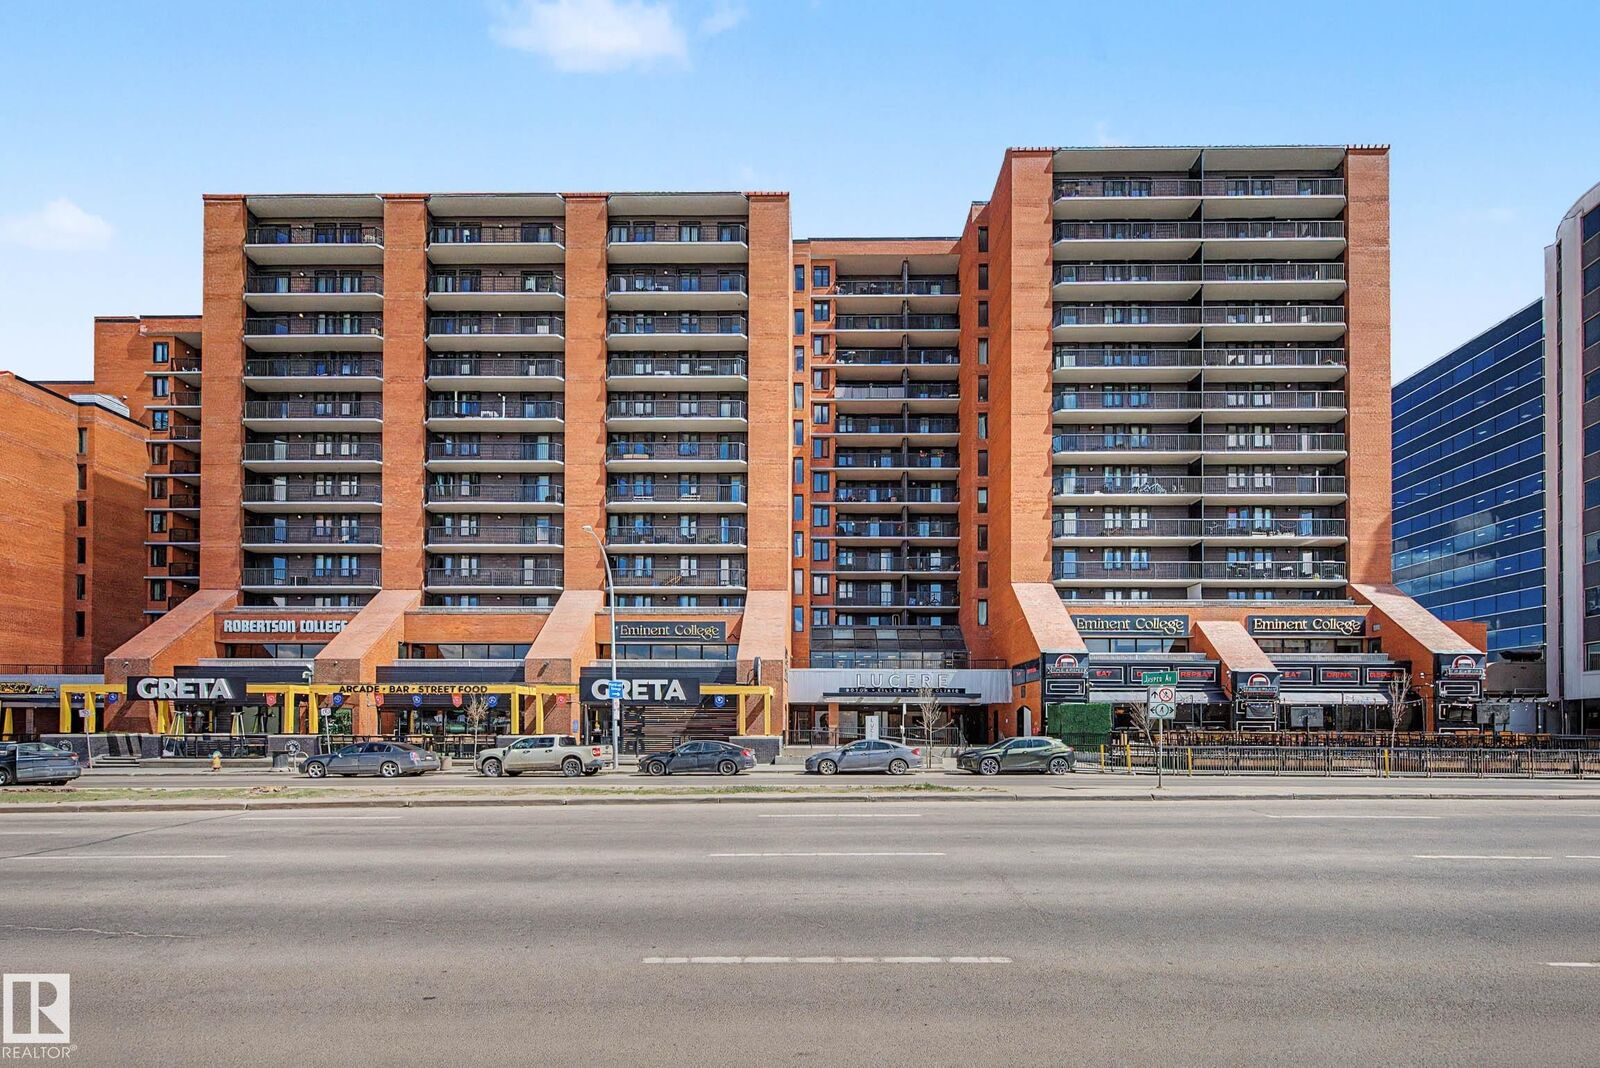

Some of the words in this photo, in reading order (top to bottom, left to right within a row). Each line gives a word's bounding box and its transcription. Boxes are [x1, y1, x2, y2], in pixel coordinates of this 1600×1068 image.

[223, 619, 296, 632] ROBERTSON
[620, 625, 670, 635] Eminent
[674, 624, 719, 640] College
[1077, 618, 1130, 630] Eminent
[1136, 618, 1184, 634] College
[1254, 619, 1307, 630] Eminent
[1312, 619, 1361, 636] College
[136, 678, 233, 699] GRETA
[856, 673, 950, 688] LUCERE
[339, 685, 380, 693] ARCADE
[389, 685, 409, 693] BAR
[418, 685, 457, 693] STREET
[458, 685, 488, 693] FOOD
[591, 679, 686, 701] GRETA
